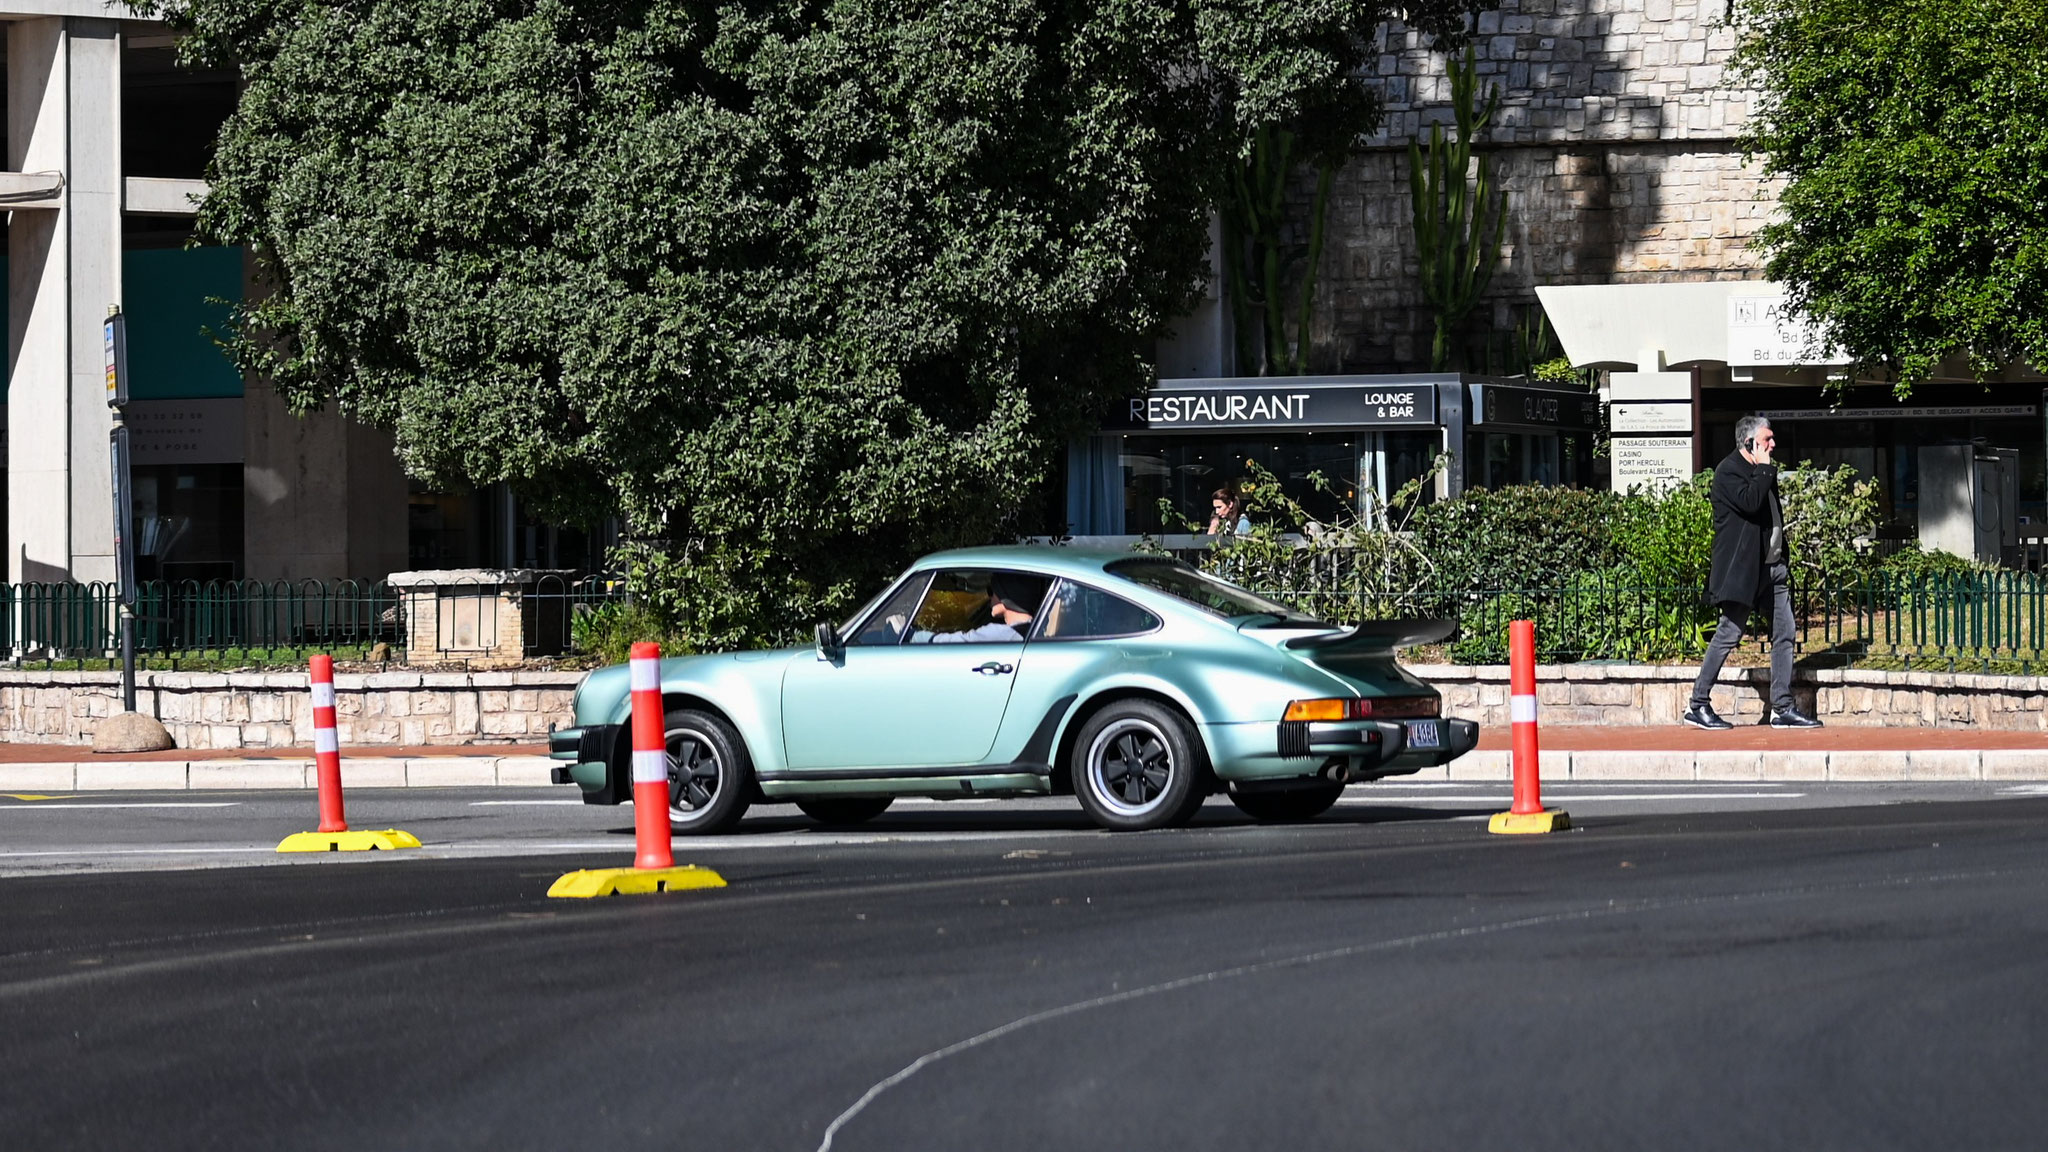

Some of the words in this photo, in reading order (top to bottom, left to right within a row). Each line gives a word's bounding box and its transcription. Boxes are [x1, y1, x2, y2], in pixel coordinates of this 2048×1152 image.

[1782, 332, 1798, 343] Bd
[1777, 350, 1792, 360] du
[1365, 393, 1414, 405] LOUNGE
[1130, 395, 1310, 421] RESTAURANT
[1377, 407, 1386, 418] &
[1389, 406, 1414, 418] BAR
[1524, 396, 1559, 422] GLACIER
